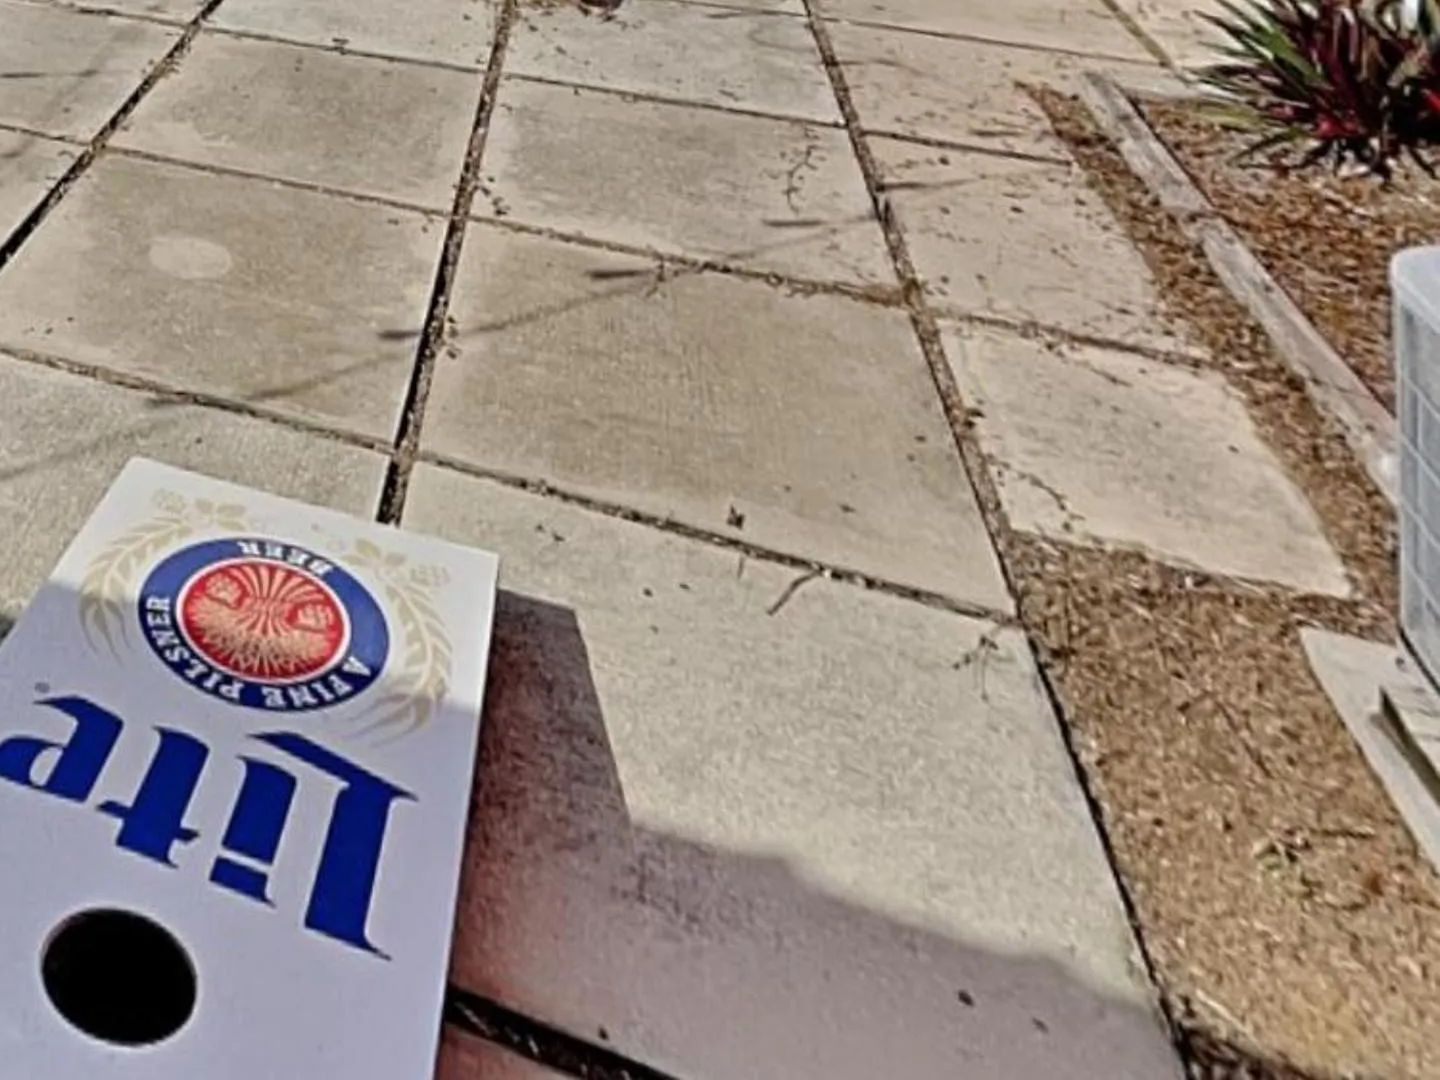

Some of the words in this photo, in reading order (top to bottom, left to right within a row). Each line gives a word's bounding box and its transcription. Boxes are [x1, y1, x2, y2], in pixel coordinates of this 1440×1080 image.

[236, 540, 334, 576] BEER
[145, 596, 245, 701] PILSNER
[347, 656, 372, 678] A
[260, 680, 354, 712] FINE
